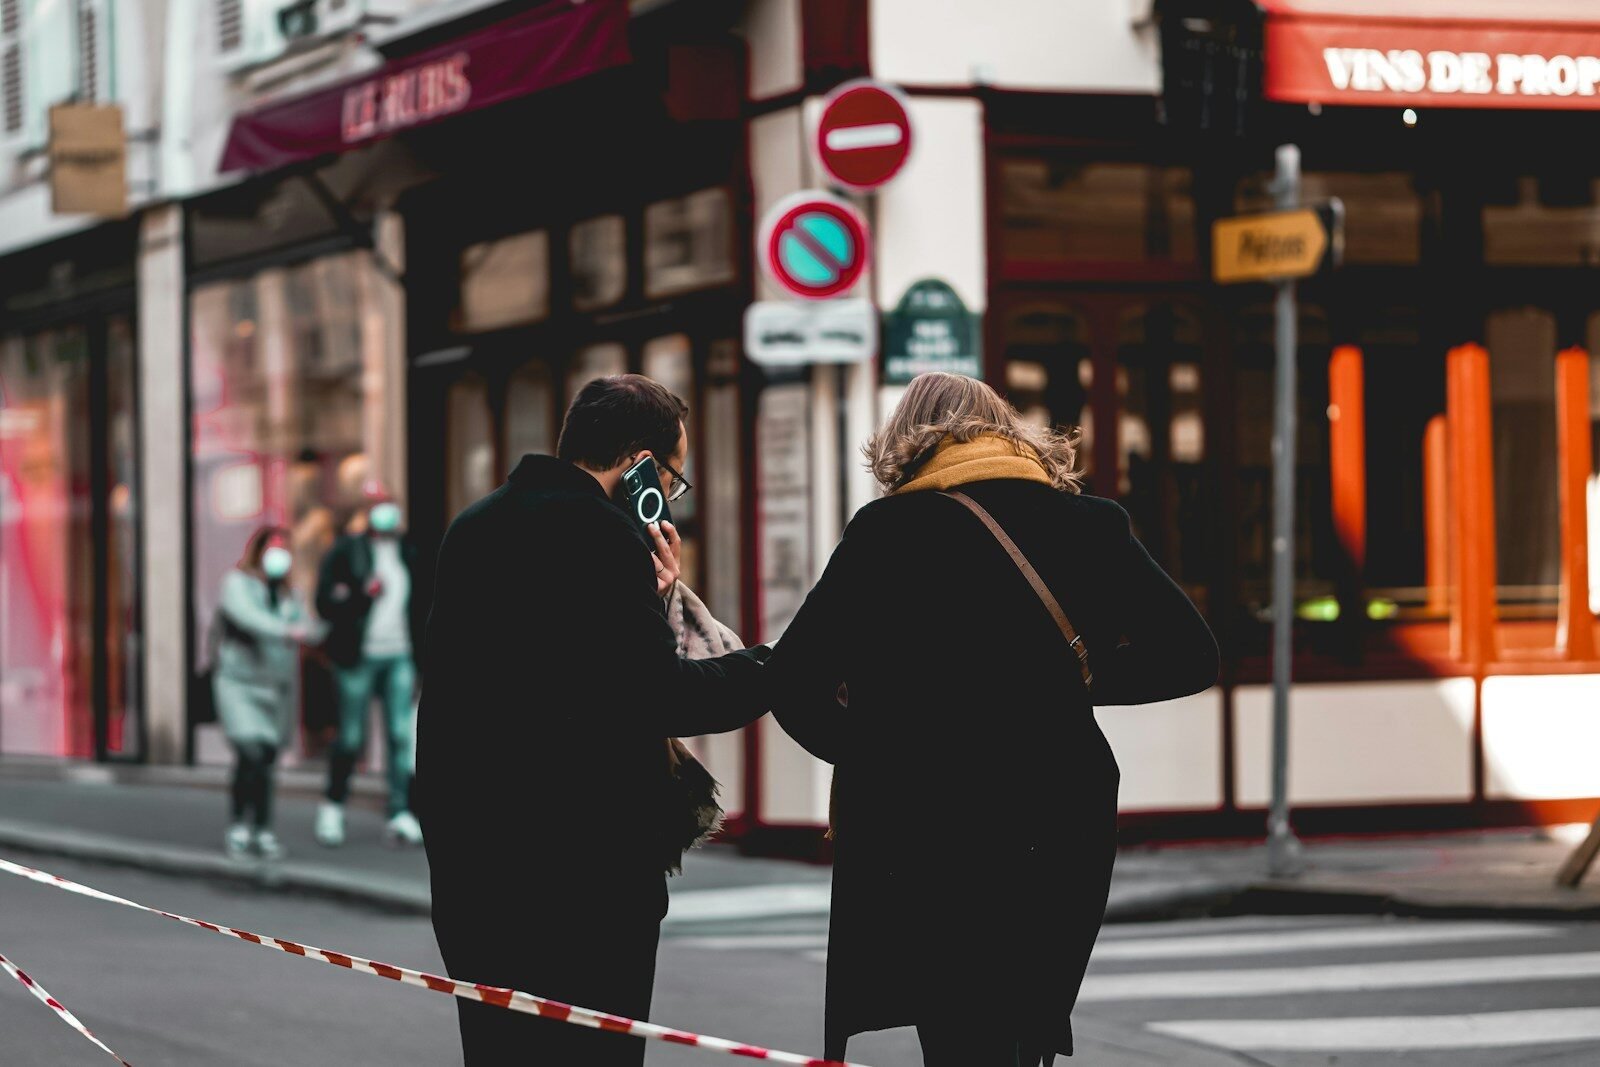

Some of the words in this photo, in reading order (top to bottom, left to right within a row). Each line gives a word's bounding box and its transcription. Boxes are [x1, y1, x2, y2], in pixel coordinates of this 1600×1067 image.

[341, 82, 379, 143] LE
[382, 54, 471, 131] RUBIS
[1323, 47, 1425, 92] VINS
[1427, 51, 1492, 94] DE
